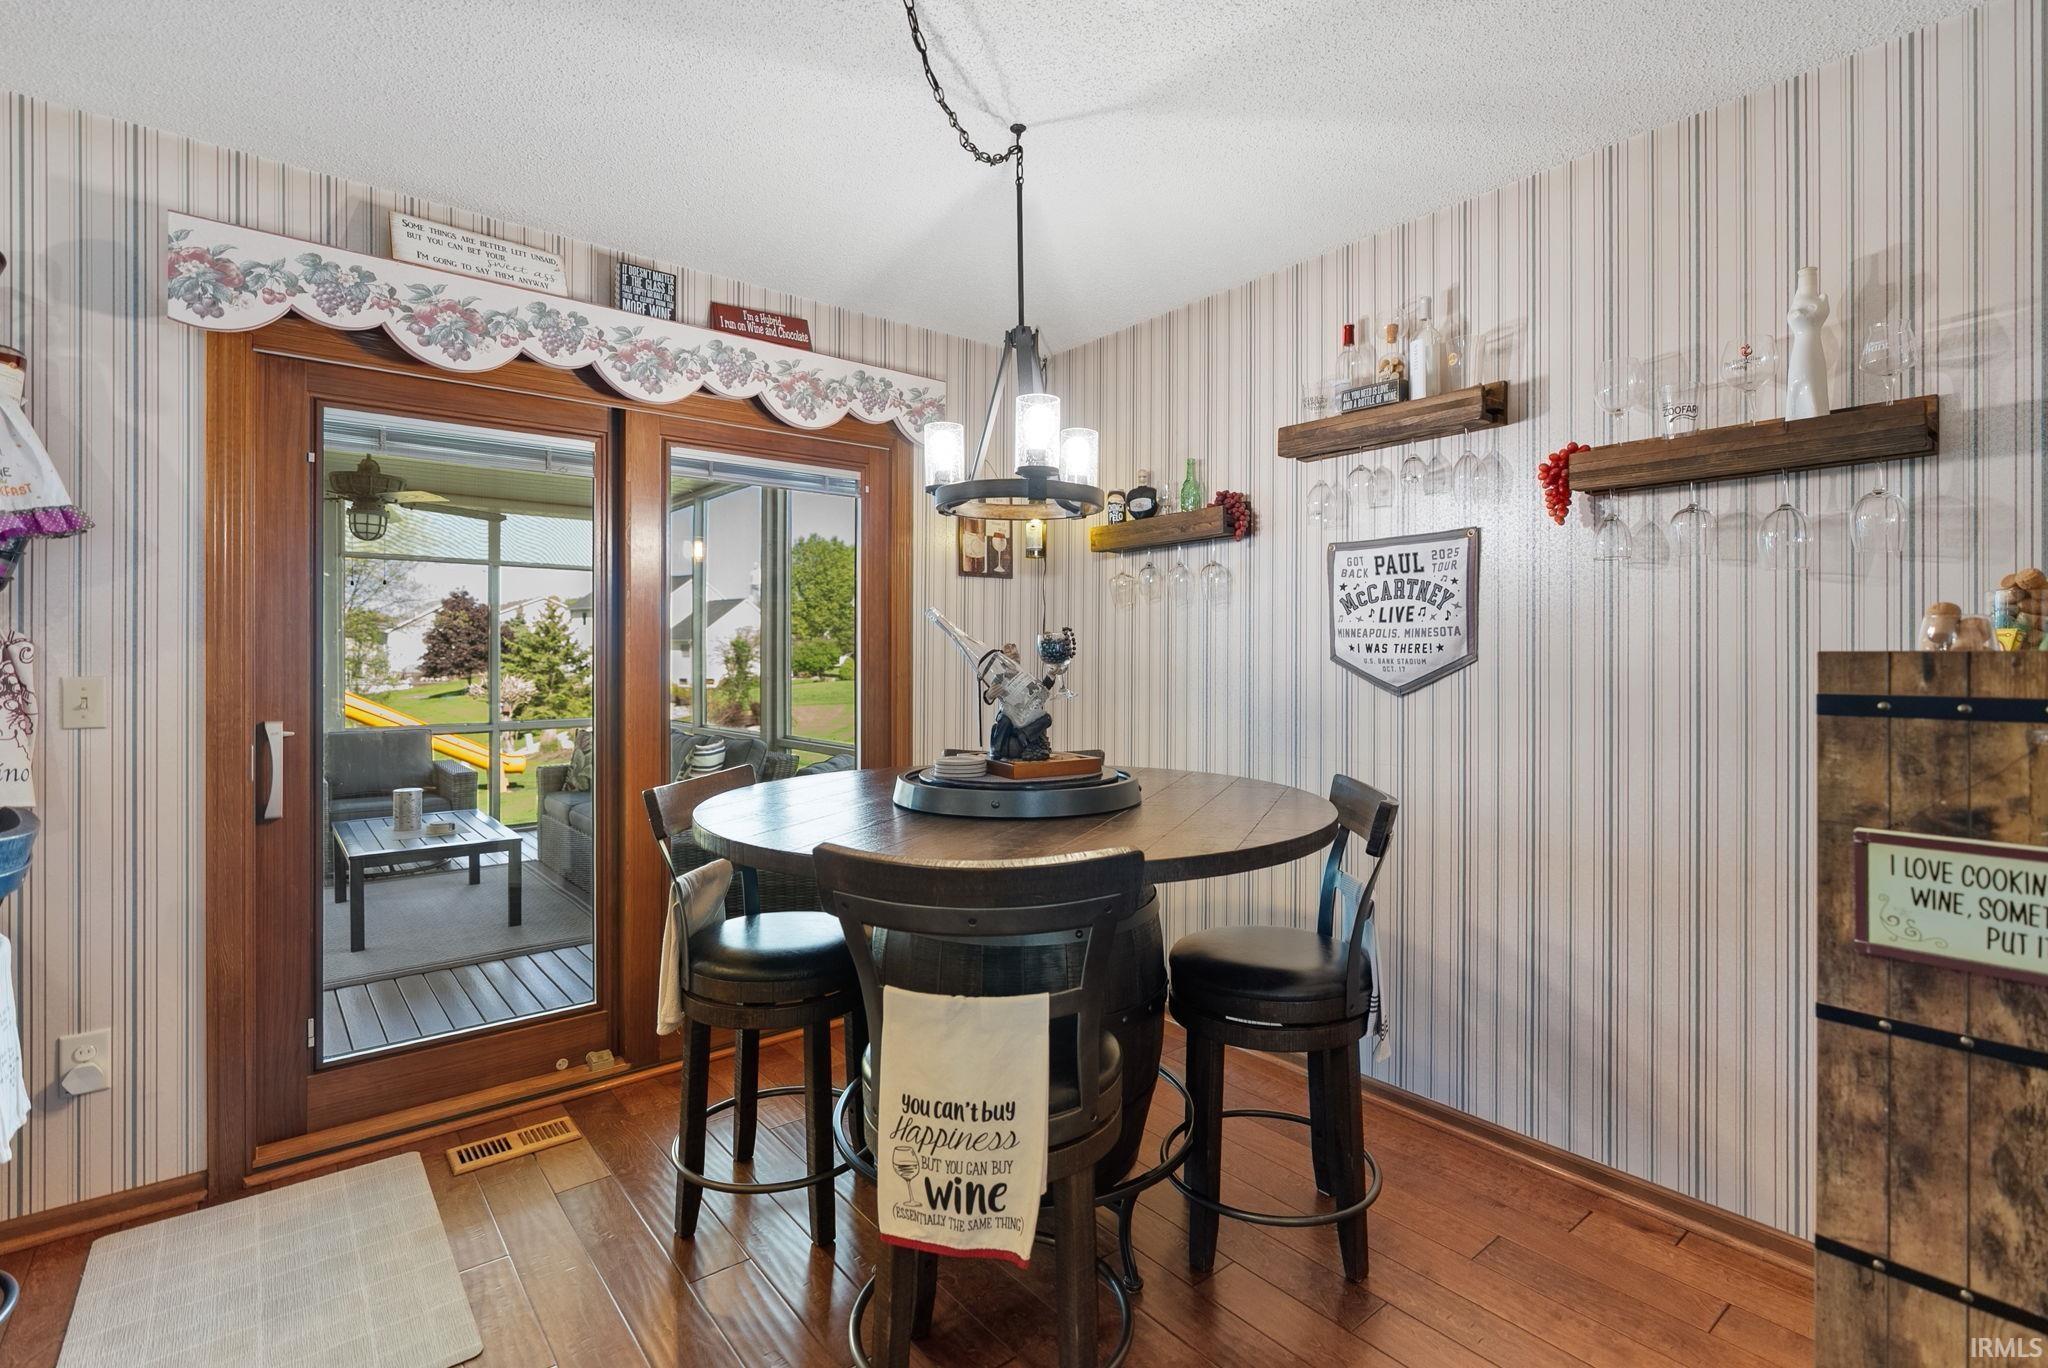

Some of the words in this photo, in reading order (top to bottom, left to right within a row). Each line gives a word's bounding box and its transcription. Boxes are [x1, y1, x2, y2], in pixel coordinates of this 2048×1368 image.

[402, 218, 425, 232] SOME
[429, 227, 457, 240] THINGS
[461, 235, 476, 245] ARE
[480, 240, 508, 253] BETTER
[511, 248, 527, 258] LEFT
[531, 253, 559, 267] UNSAID,
[406, 231, 422, 241] BUT
[427, 236, 444, 246] YOU
[447, 241, 463, 251] CAN
[467, 246, 481, 256] BET
[485, 251, 506, 262] YOUR
[416, 250, 429, 261] I'M
[433, 256, 458, 268] GOING
[461, 262, 472, 271] TO
[475, 266, 490, 275] SAY
[494, 270, 515, 281] THEM
[519, 276, 549, 290] ANYWAY
[622, 263, 628, 274] IT
[629, 265, 652, 279] DOESN'T
[653, 271, 674, 284] MATTER
[622, 273, 628, 285] IF
[631, 275, 643, 289] THE
[646, 279, 665, 293] GLASS
[668, 284, 674, 296] IS
[622, 298, 648, 316] MORE
[649, 305, 672, 320] WINE
[755, 315, 760, 323] a
[720, 315, 724, 327] I
[724, 319, 737, 330] run
[737, 322, 747, 332] on
[746, 320, 765, 334] Wine
[765, 325, 778, 338] and
[778, 326, 809, 343] Chocolate
[1346, 556, 1364, 567] GOT
[1374, 552, 1425, 576] PAUL
[1431, 547, 1460, 560] 2025
[1340, 568, 1369, 579] BACK
[1432, 559, 1458, 573] TOUR
[1379, 605, 1415, 623] LIVE
[1337, 628, 1401, 639] MINNEAPOLIS,
[1404, 626, 1461, 638] MINNESOTA
[1357, 643, 1361, 653] I
[1365, 643, 1388, 653] WAS
[1394, 643, 1433, 653] THERE!
[1890, 854, 1895, 876] I
[1904, 857, 1953, 884] LOVE
[1961, 865, 2048, 898] COOKIN
[1910, 886, 1972, 919] WINE,
[1979, 896, 2048, 930] SOMET
[1987, 927, 2028, 955] PUT
[2038, 935, 2048, 959] I
[901, 1093, 930, 1119] you
[934, 1100, 978, 1122] can't
[981, 1100, 1016, 1122] buy
[890, 1115, 1020, 1156] Happiness
[921, 1156, 942, 1174] BUT
[945, 1160, 963, 1175] YOU
[966, 1161, 988, 1176] CAN
[991, 1160, 1014, 1175] BUY
[924, 1176, 1008, 1215] wine
[892, 1202, 947, 1227] (ESSENTIALLY
[948, 1217, 965, 1232] THE
[967, 1217, 992, 1232] SAME
[995, 1217, 1025, 1236] THING)
